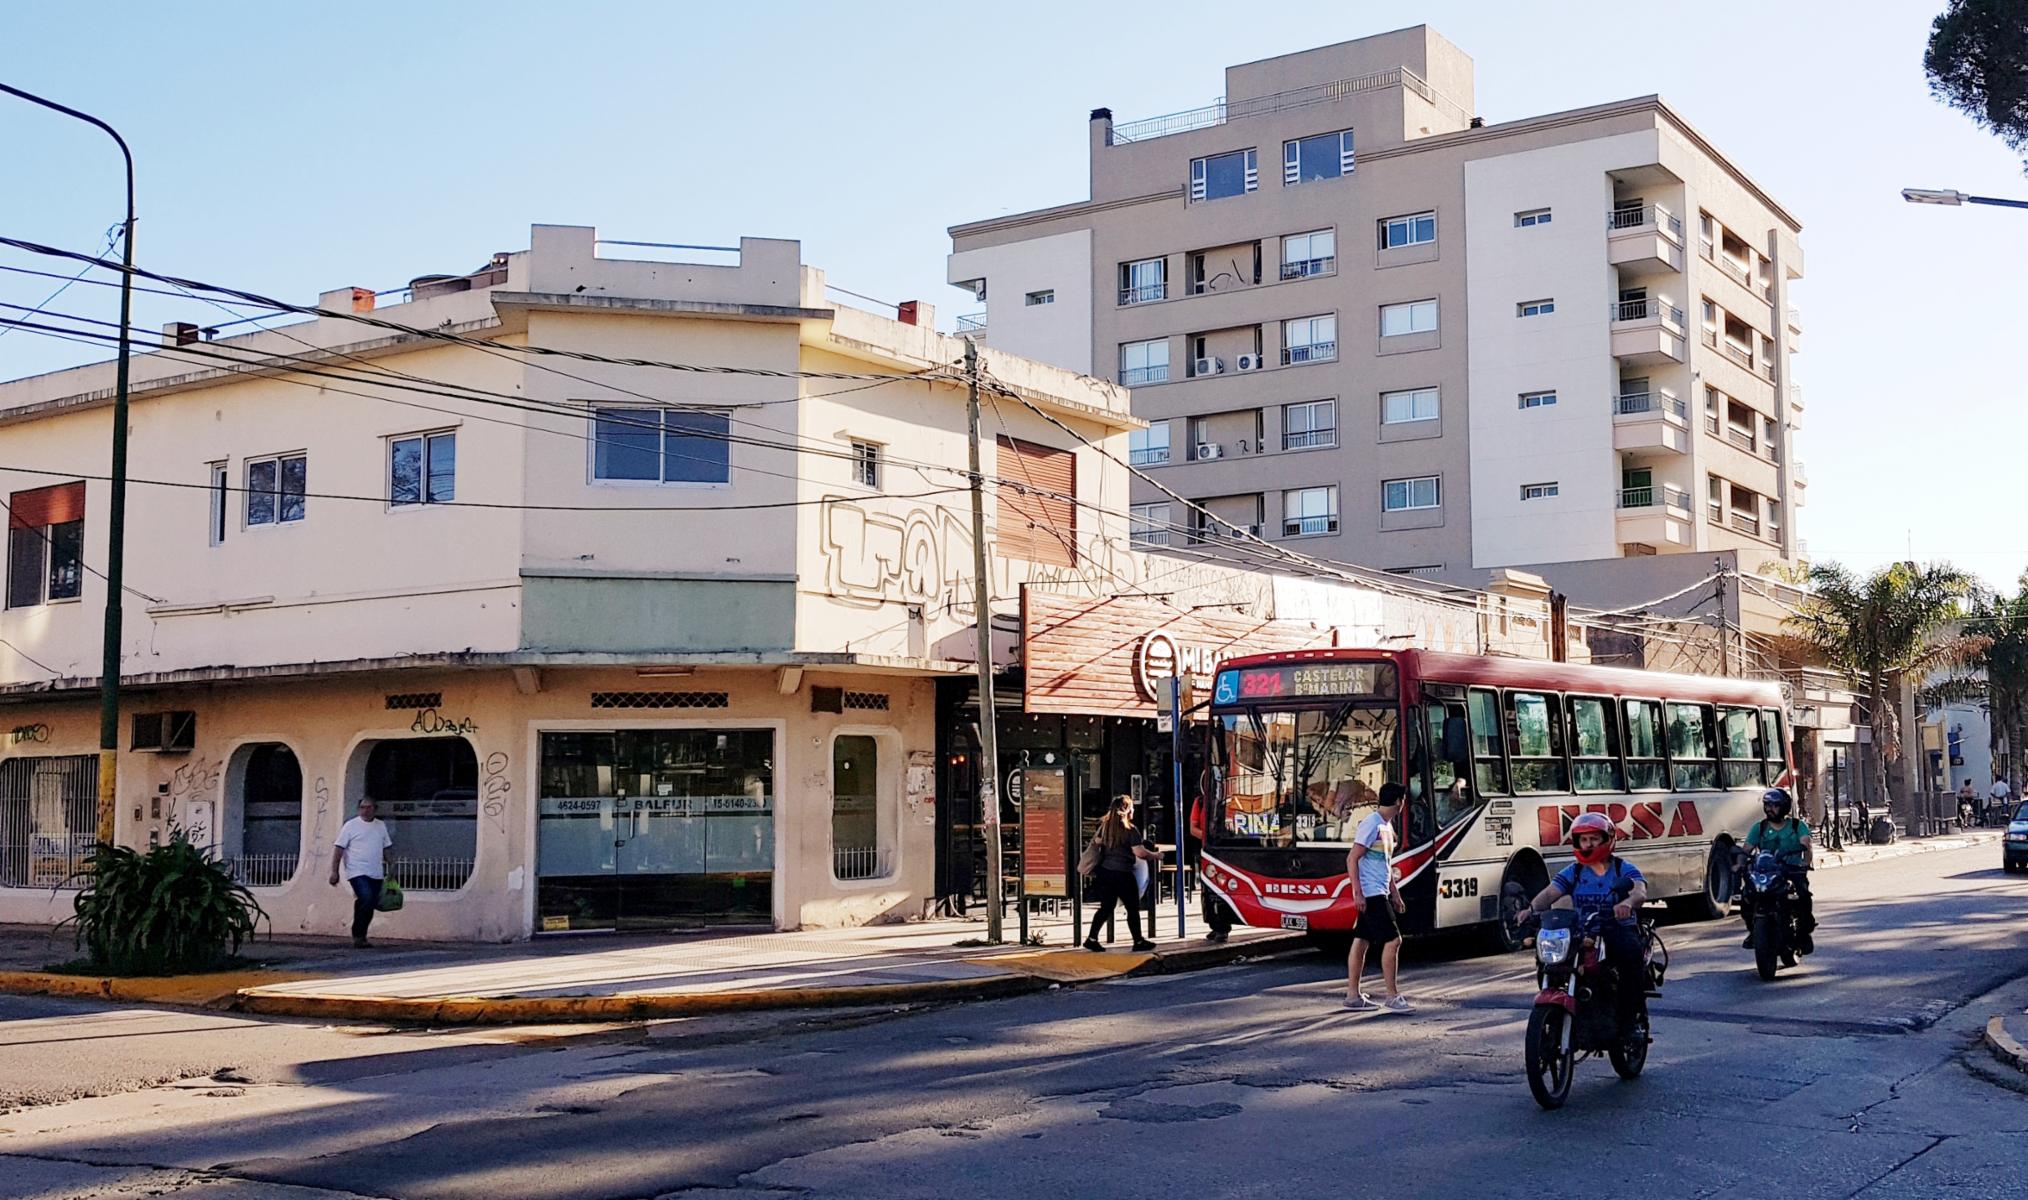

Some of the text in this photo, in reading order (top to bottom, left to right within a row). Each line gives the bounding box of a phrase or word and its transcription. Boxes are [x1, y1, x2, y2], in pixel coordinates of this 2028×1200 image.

[1293, 668, 1364, 682] CASTELAR
[1296, 814, 1316, 828] 3319
[1537, 801, 1703, 846] ERSA
[1265, 883, 1328, 895] ERSA
[1441, 877, 1478, 899] 3319
